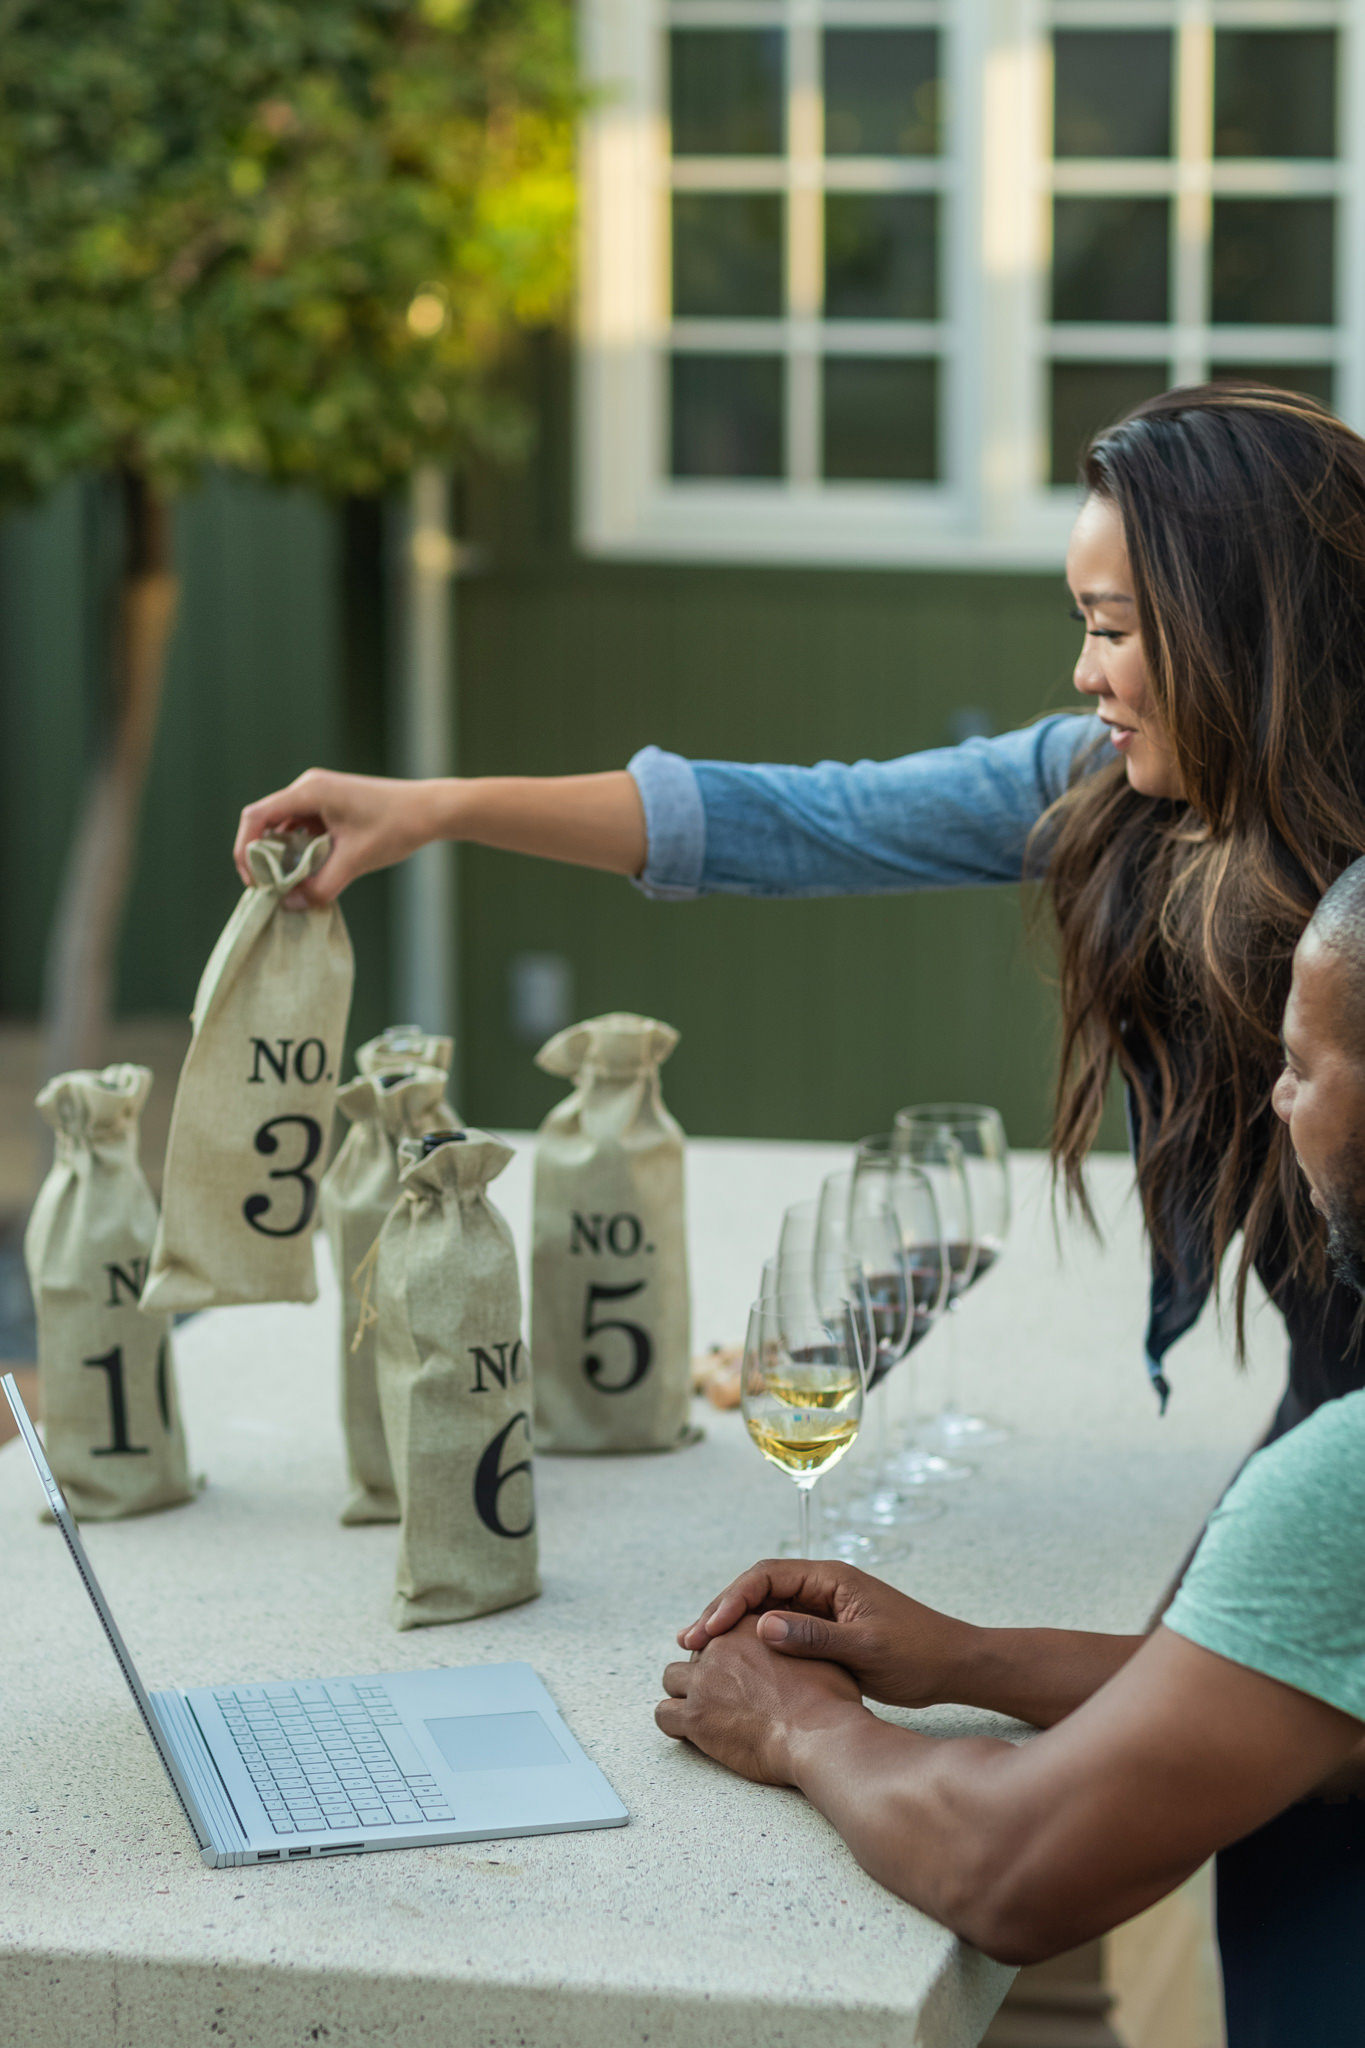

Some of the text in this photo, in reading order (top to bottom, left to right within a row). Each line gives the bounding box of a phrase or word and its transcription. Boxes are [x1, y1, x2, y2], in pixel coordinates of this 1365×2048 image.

[247, 1036, 333, 1085] NO.
[242, 1113, 323, 1238] 3
[570, 1211, 656, 1258] NO.
[102, 1256, 151, 1306] N
[583, 1278, 655, 1396] 5
[82, 1333, 172, 1457] 1
[474, 1411, 534, 1539] 6
